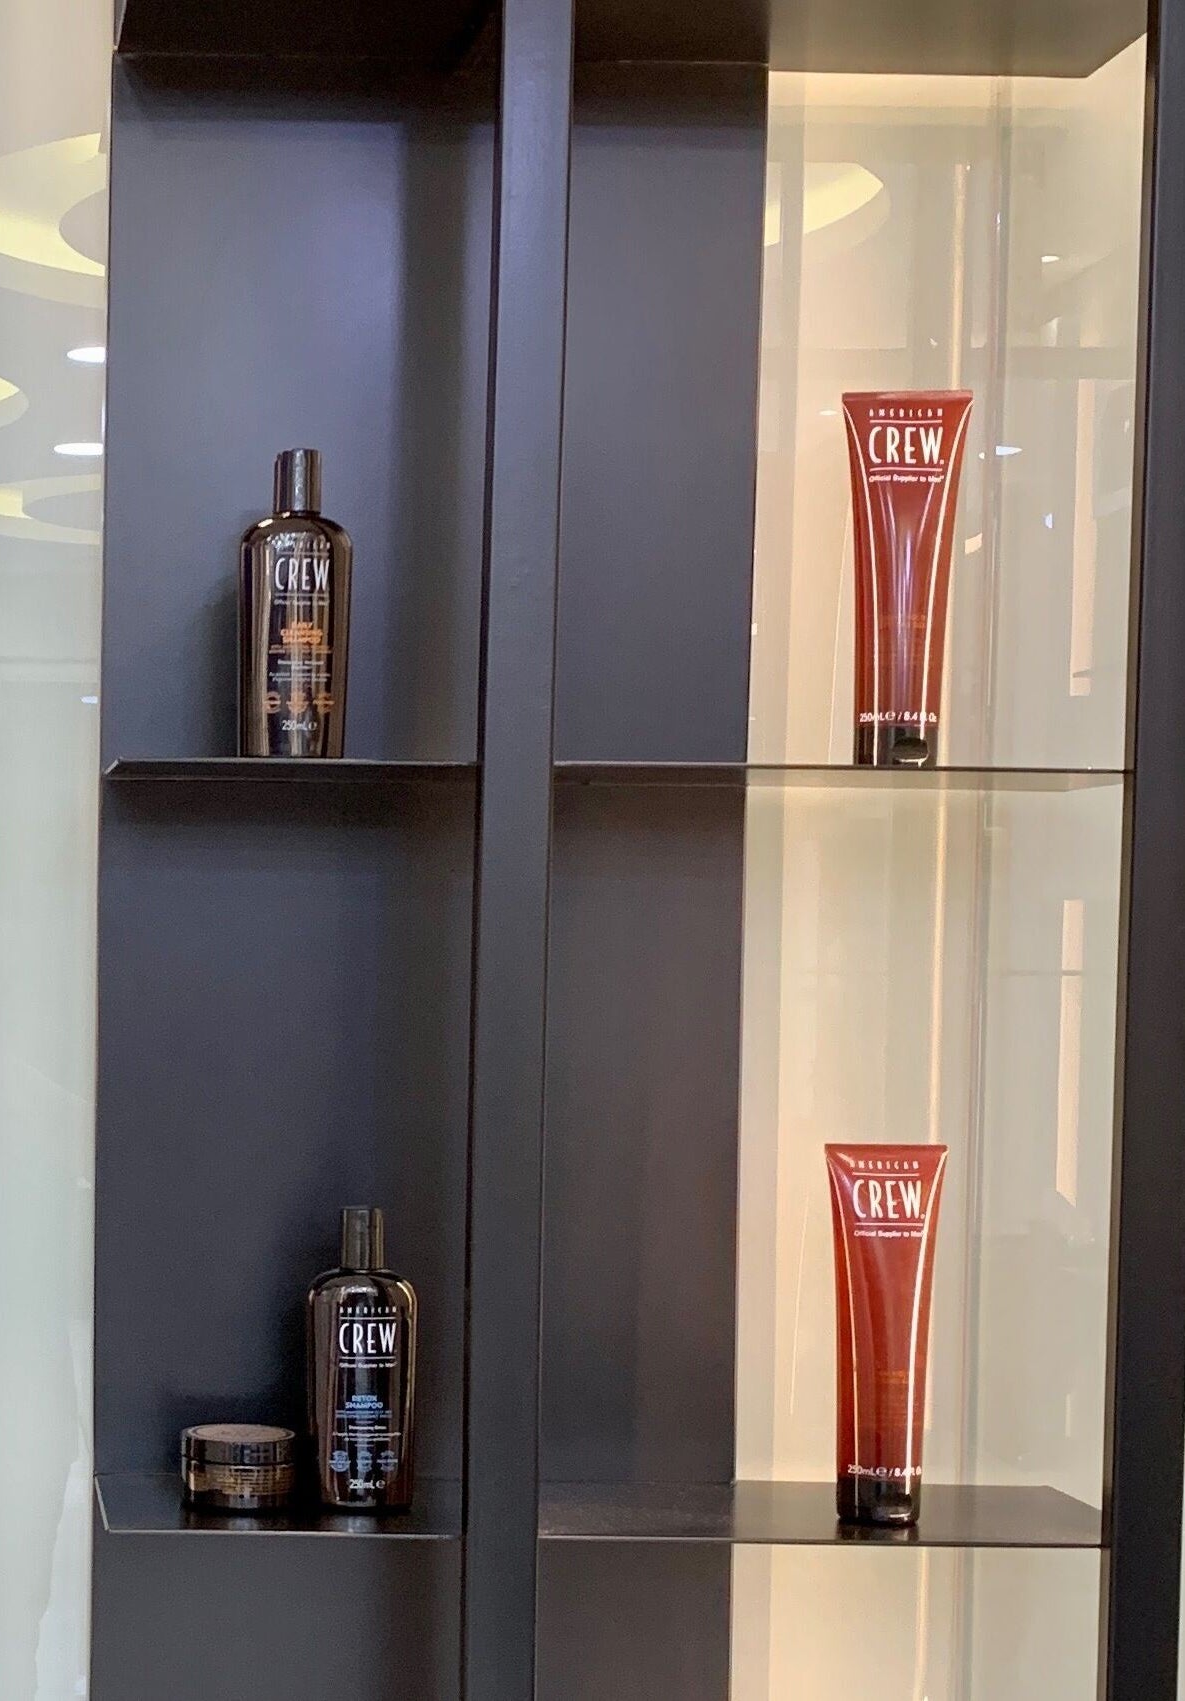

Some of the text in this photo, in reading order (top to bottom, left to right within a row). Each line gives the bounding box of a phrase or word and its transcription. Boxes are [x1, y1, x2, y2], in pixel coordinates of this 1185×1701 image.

[868, 408, 943, 418] AMERICAN
[274, 558, 331, 591] CREW
[338, 1323, 397, 1354] CREW
[344, 1401, 384, 1409] SHAMPOO
